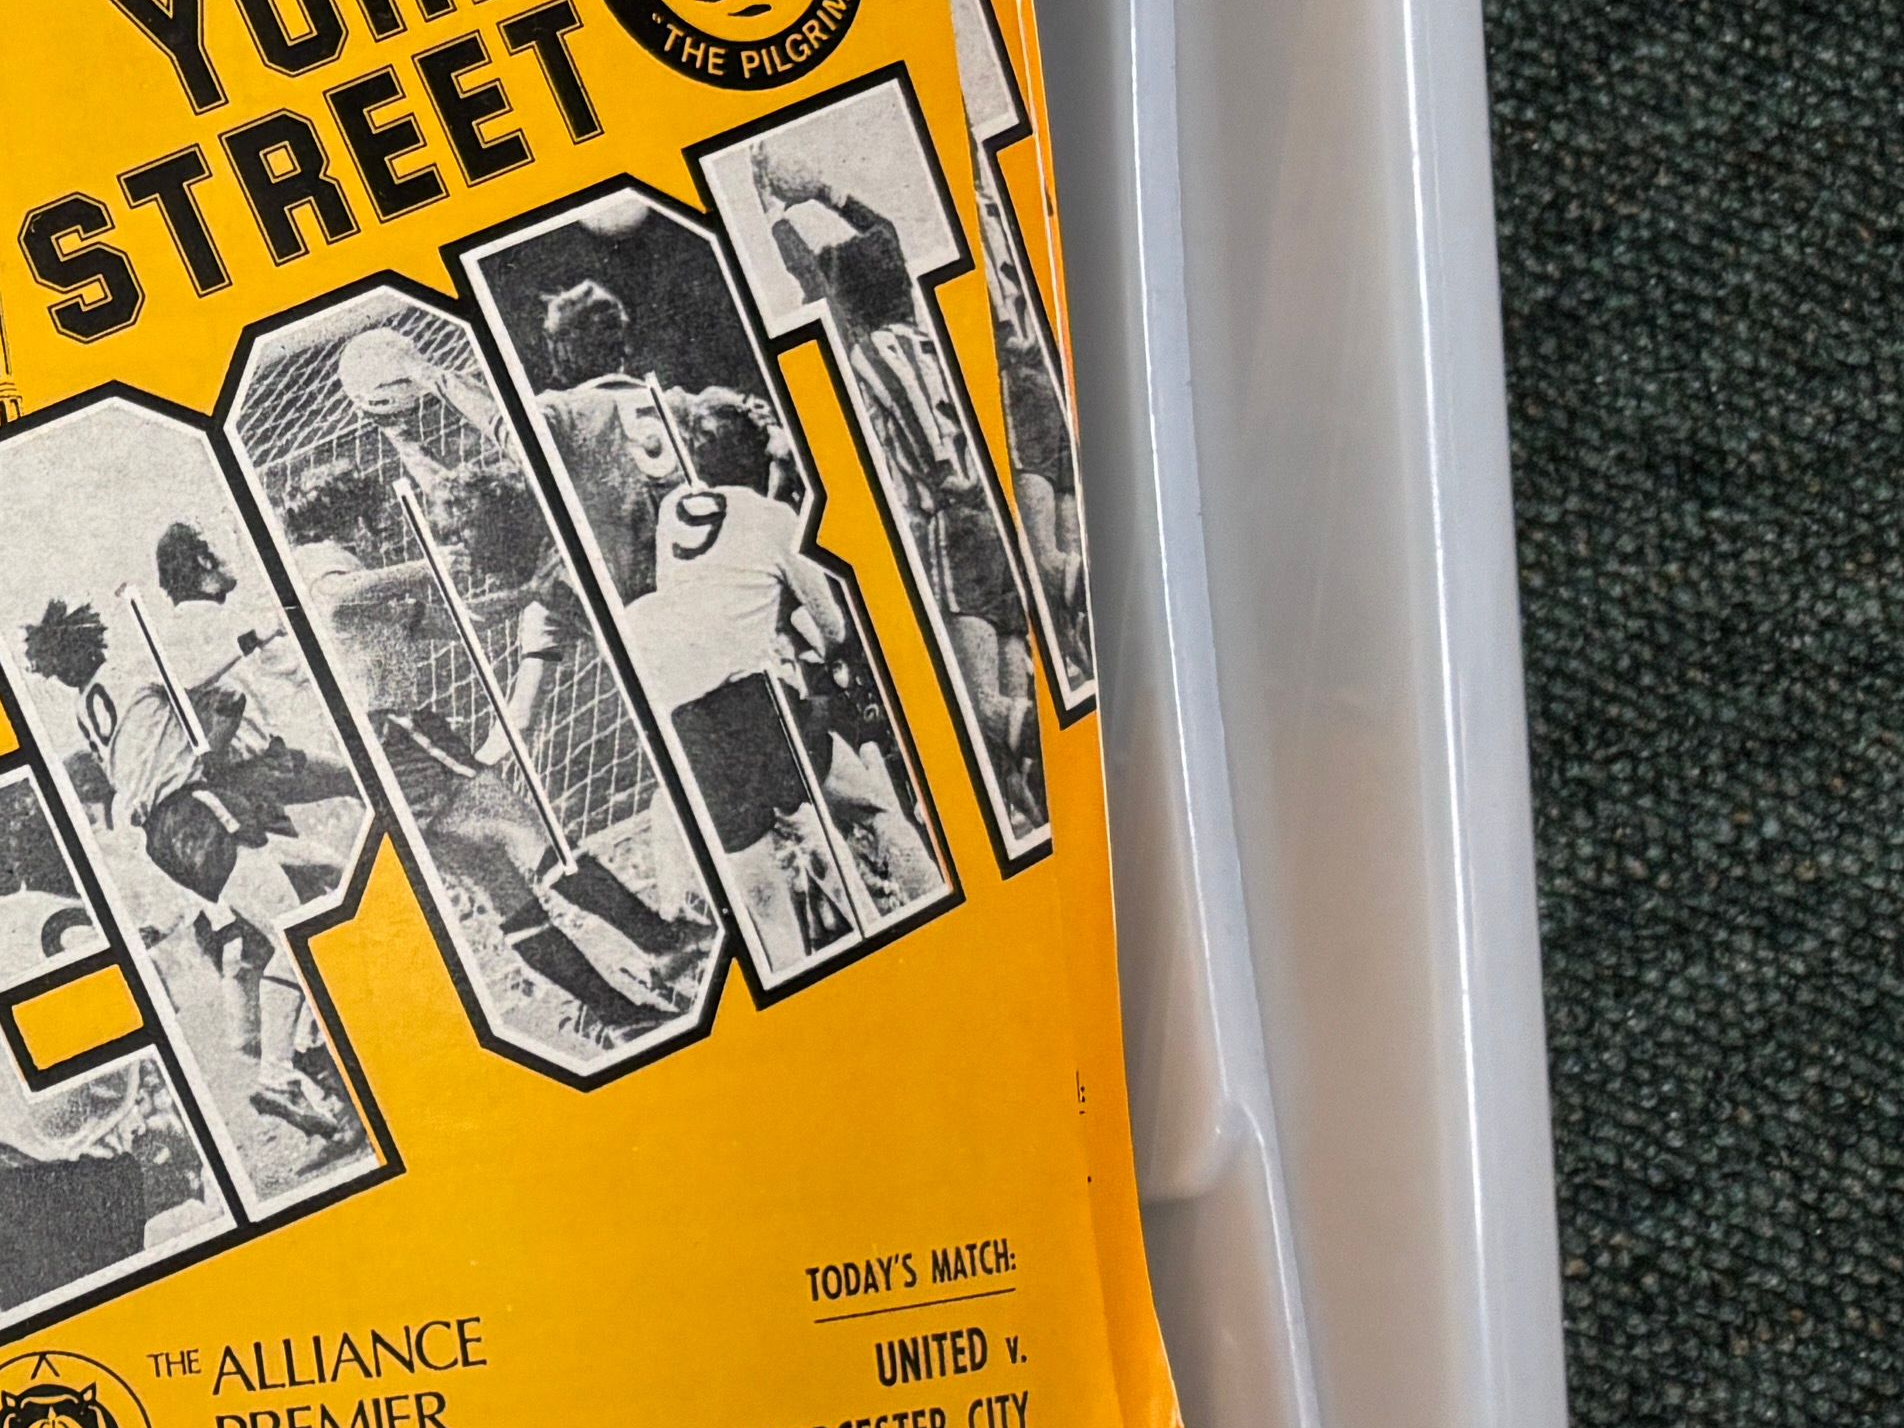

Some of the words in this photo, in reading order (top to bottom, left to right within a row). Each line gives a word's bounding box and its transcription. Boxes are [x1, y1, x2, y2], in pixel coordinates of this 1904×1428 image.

[806, 1254, 917, 1301] TODAY'S
[932, 1239, 1016, 1283] MATCH:
[148, 1349, 200, 1377] THE
[213, 1317, 486, 1395] ALLIANCE
[876, 1328, 987, 1386] UNITED
[1006, 1336, 1027, 1364] v.
